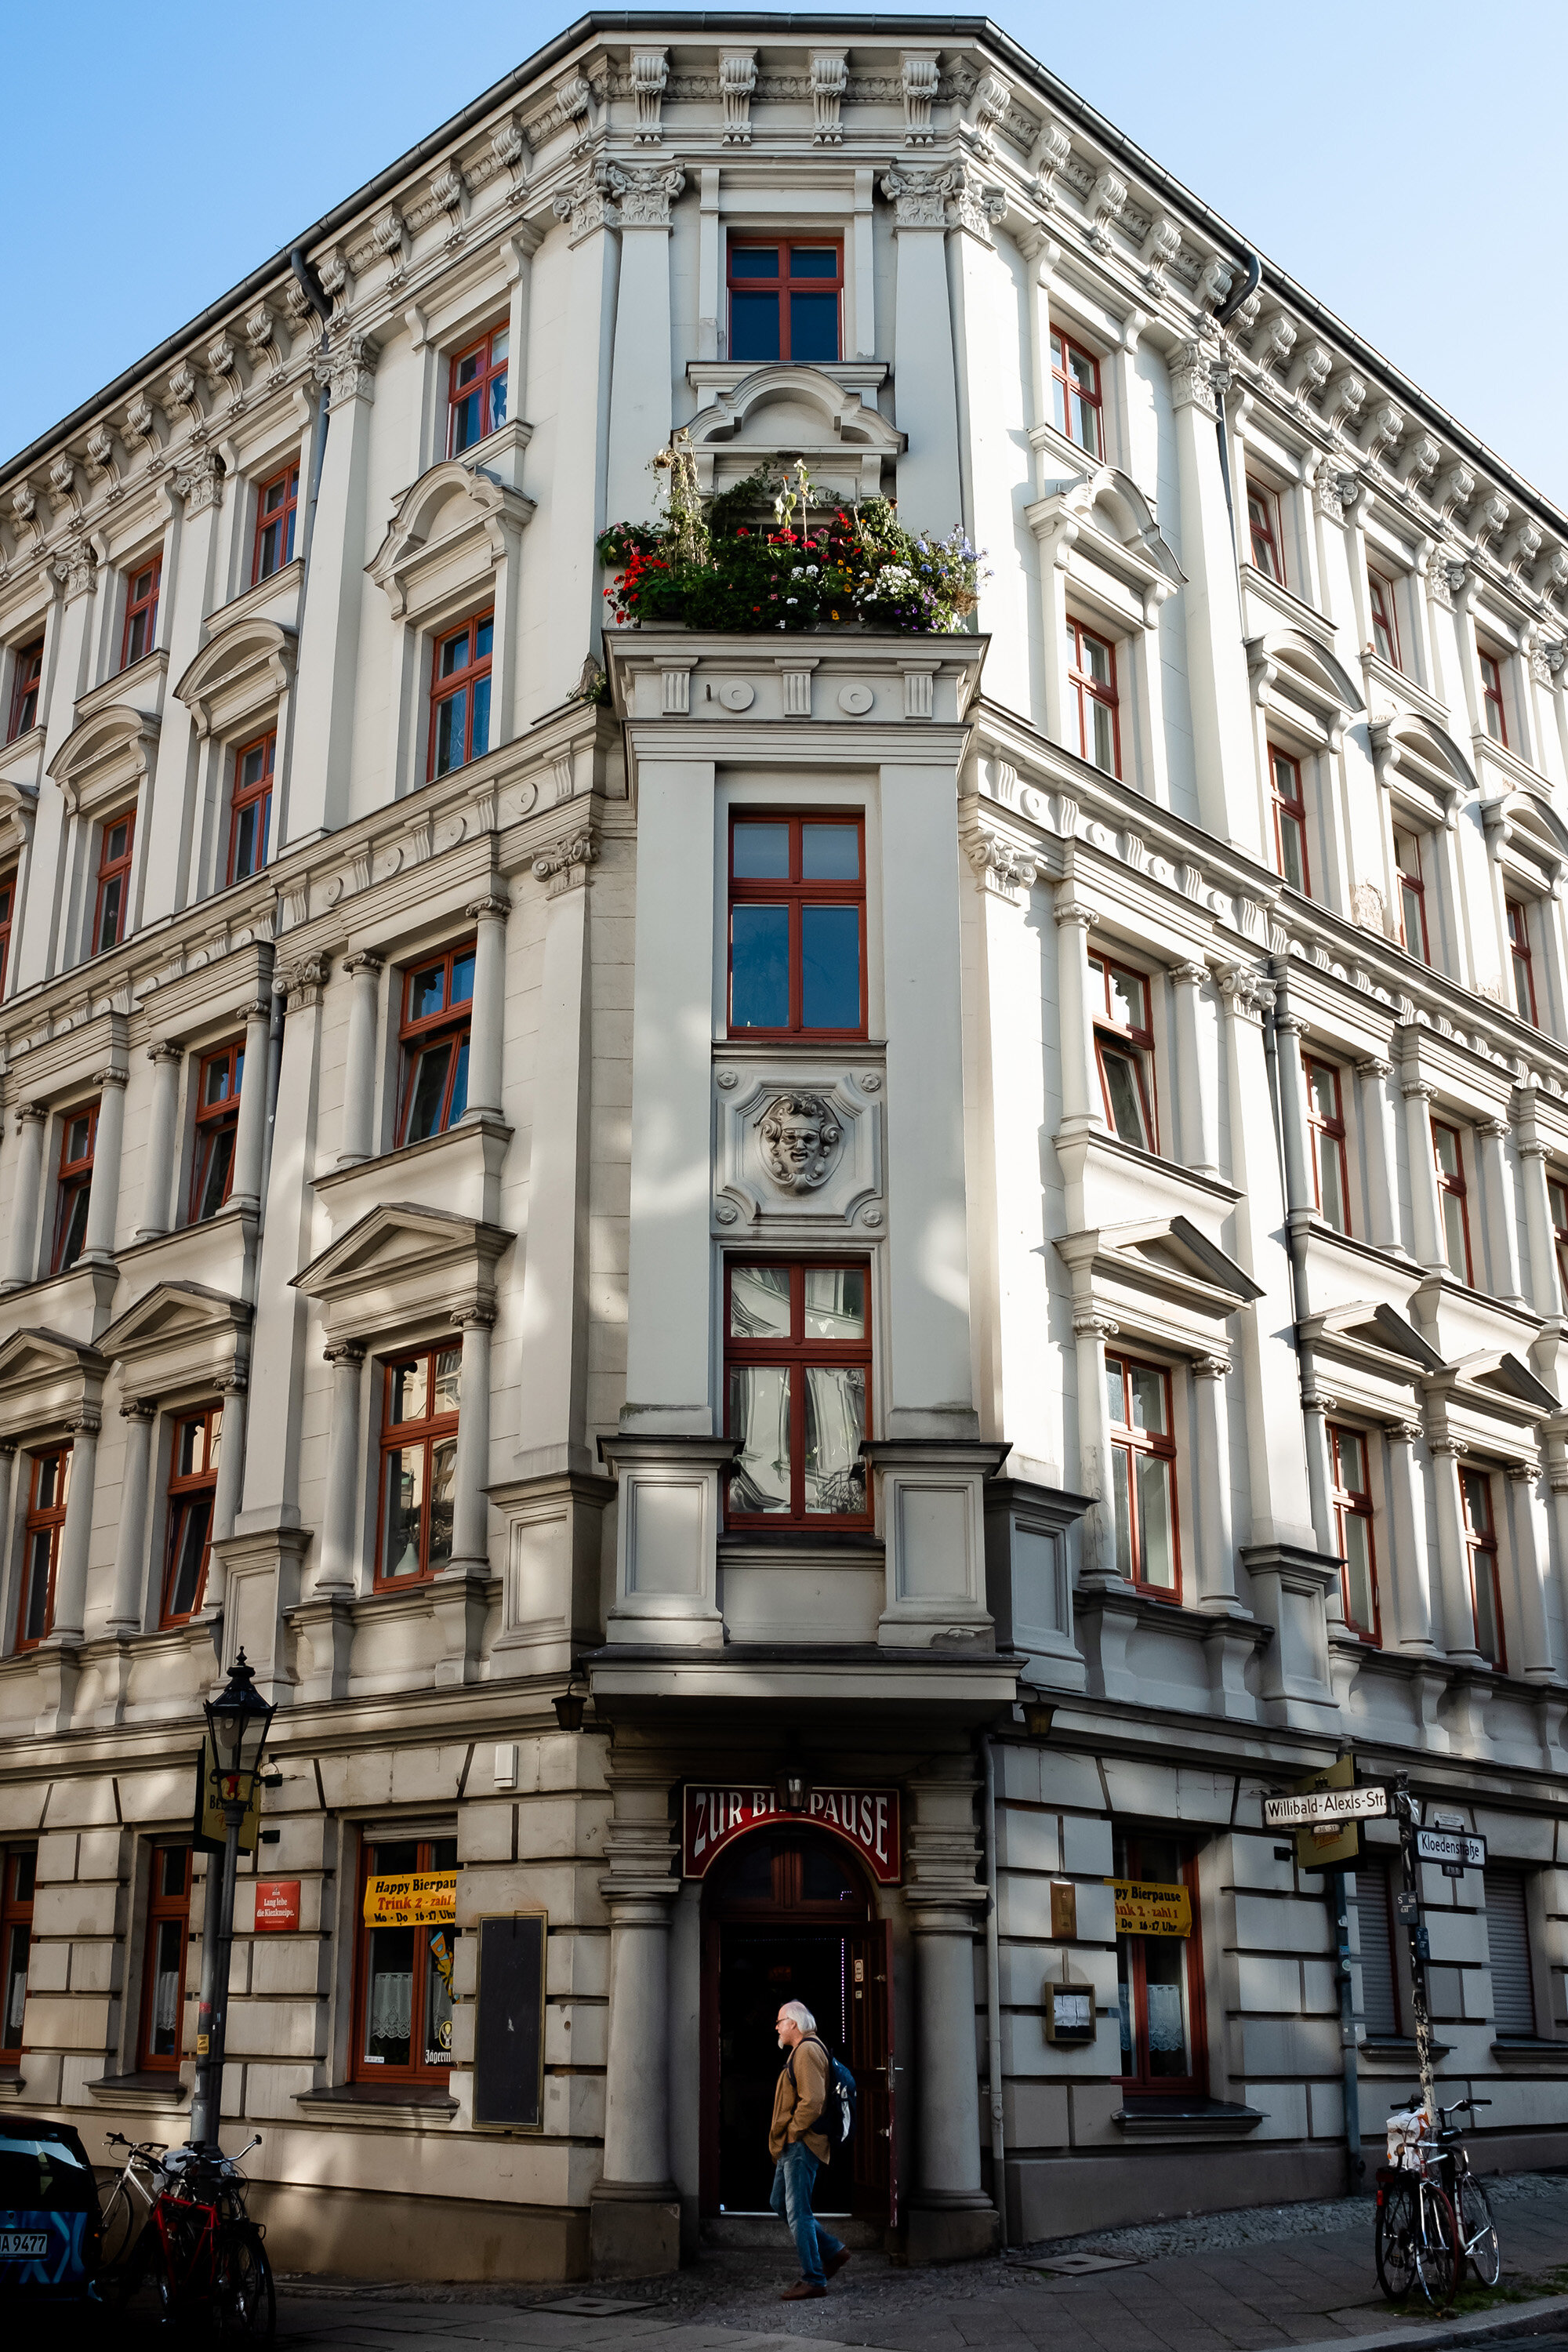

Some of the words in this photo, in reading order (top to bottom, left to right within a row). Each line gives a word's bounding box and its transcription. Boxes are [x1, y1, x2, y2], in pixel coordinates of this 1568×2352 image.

[1268, 1791, 1386, 1817] Willibald-Alexis-Str.
[695, 1792, 743, 1857] ZUR
[752, 1792, 888, 1864] BIPAUSE
[1421, 1834, 1479, 1860] Kloedenstraße
[376, 1881, 410, 1894] Happy
[412, 1878, 456, 1892] Bierpau
[378, 1896, 412, 1910] Trink
[415, 1897, 423, 1908] 2
[430, 1895, 452, 1907] zahl
[1131, 1886, 1181, 1904] Bierpause
[263, 1898, 276, 1908] Lang
[256, 1909, 265, 1918] die
[374, 1913, 387, 1922] Mo
[396, 1913, 408, 1922] Do
[1137, 1906, 1145, 1917] 2
[1152, 1907, 1172, 1918] zahl
[1173, 1910, 1178, 1918] 1
[1121, 1918, 1132, 1929] Do
[1161, 1922, 1177, 1932] Uhr
[424, 2049, 451, 2064] Jägerm
[0, 2235, 9, 2252] A
[13, 2235, 45, 2252] 9477
